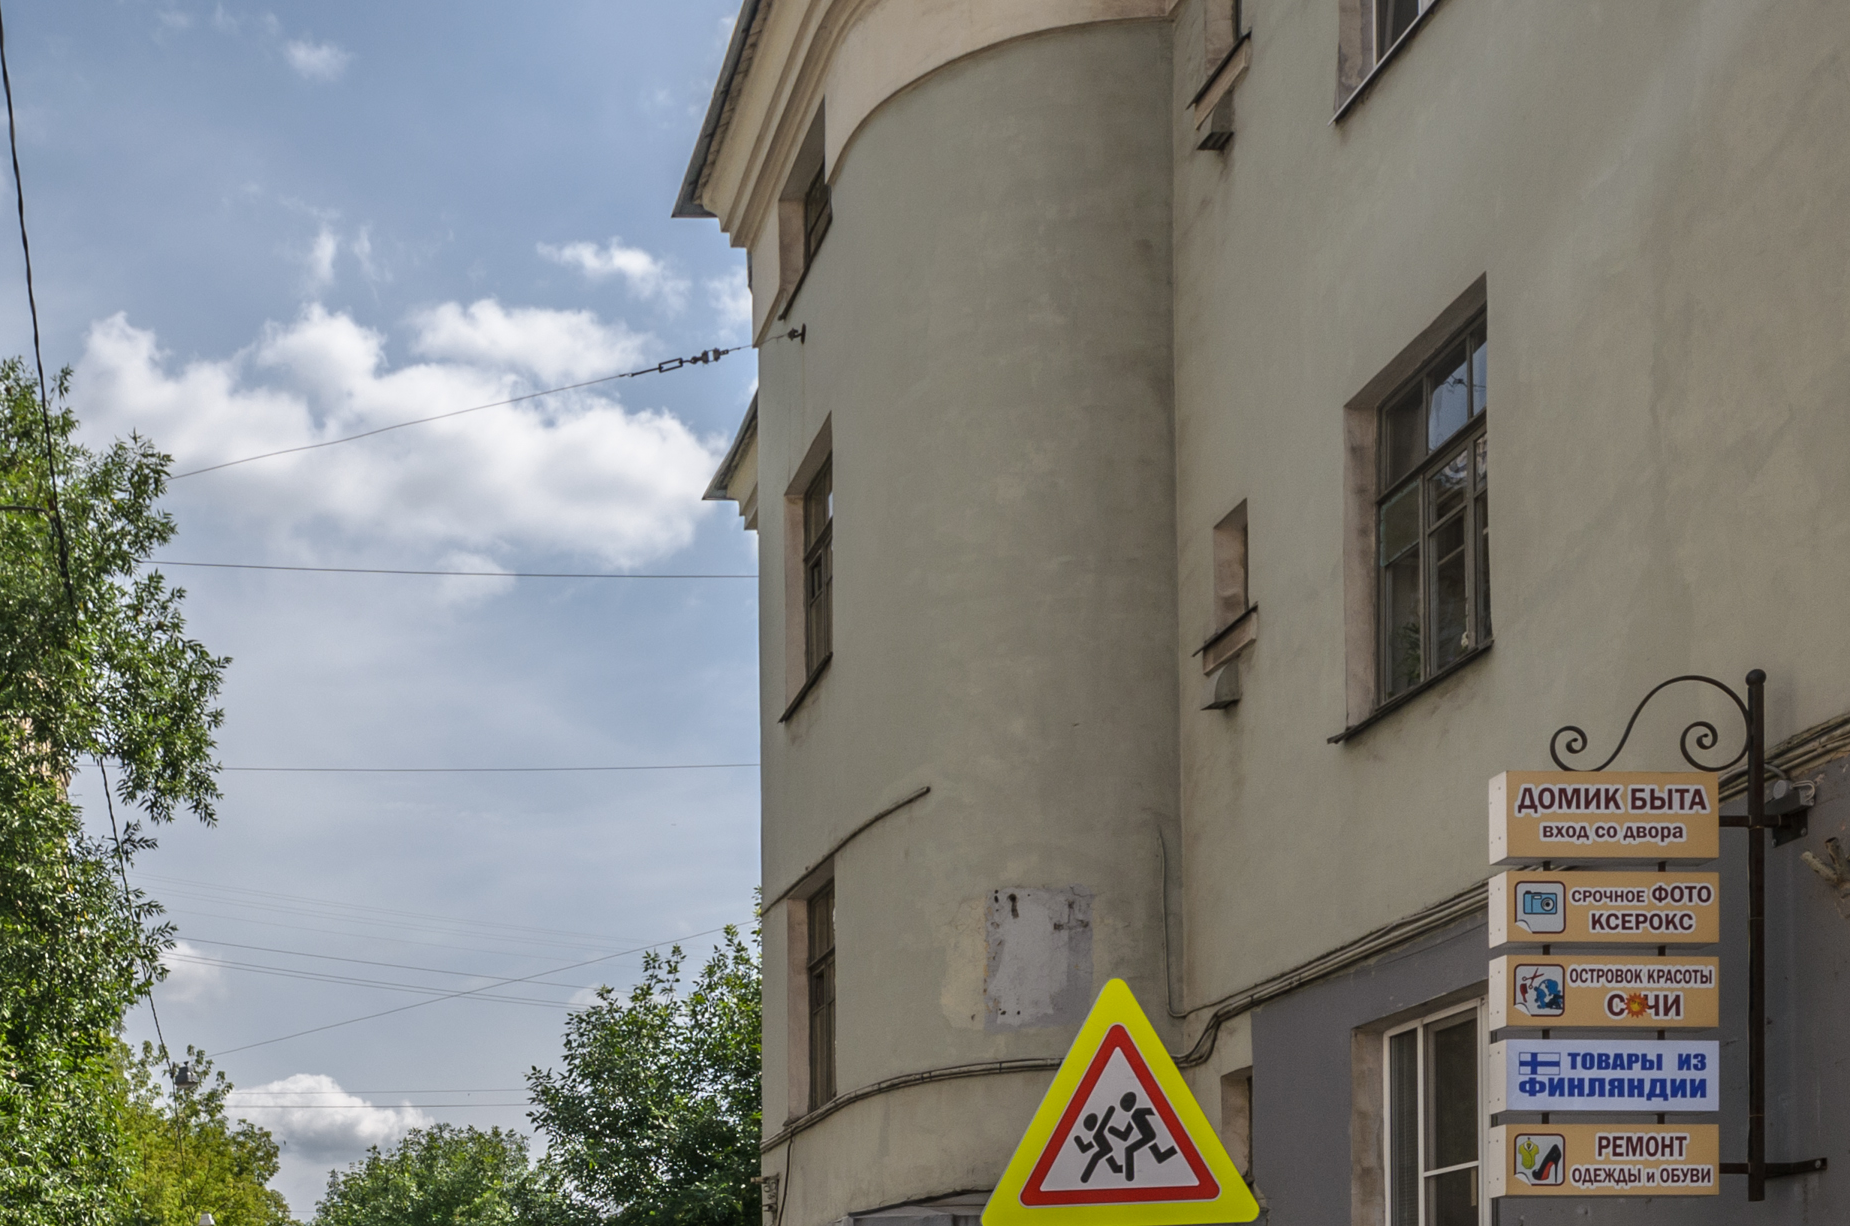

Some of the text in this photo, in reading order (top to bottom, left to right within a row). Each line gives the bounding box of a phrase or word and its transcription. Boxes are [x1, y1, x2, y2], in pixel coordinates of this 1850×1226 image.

[1517, 787, 1707, 813] ДОМИК БЫТА
[1542, 825, 1684, 842] вход со двора
[1571, 885, 1712, 904] СРОЧНОЕ ФОТО
[1591, 913, 1694, 931] КСЕРОКС
[1569, 968, 1712, 985] ОСТРОВОК КРАСОТЫ
[1567, 1052, 1707, 1071] ТОВАРЫ ИЗ
[1518, 1077, 1707, 1101] ФИНЛЯНДИИ
[1597, 1136, 1687, 1157] РЕМОНТ
[1572, 1168, 1712, 1186] ОДЕЖДЫ и ОБУВИ
